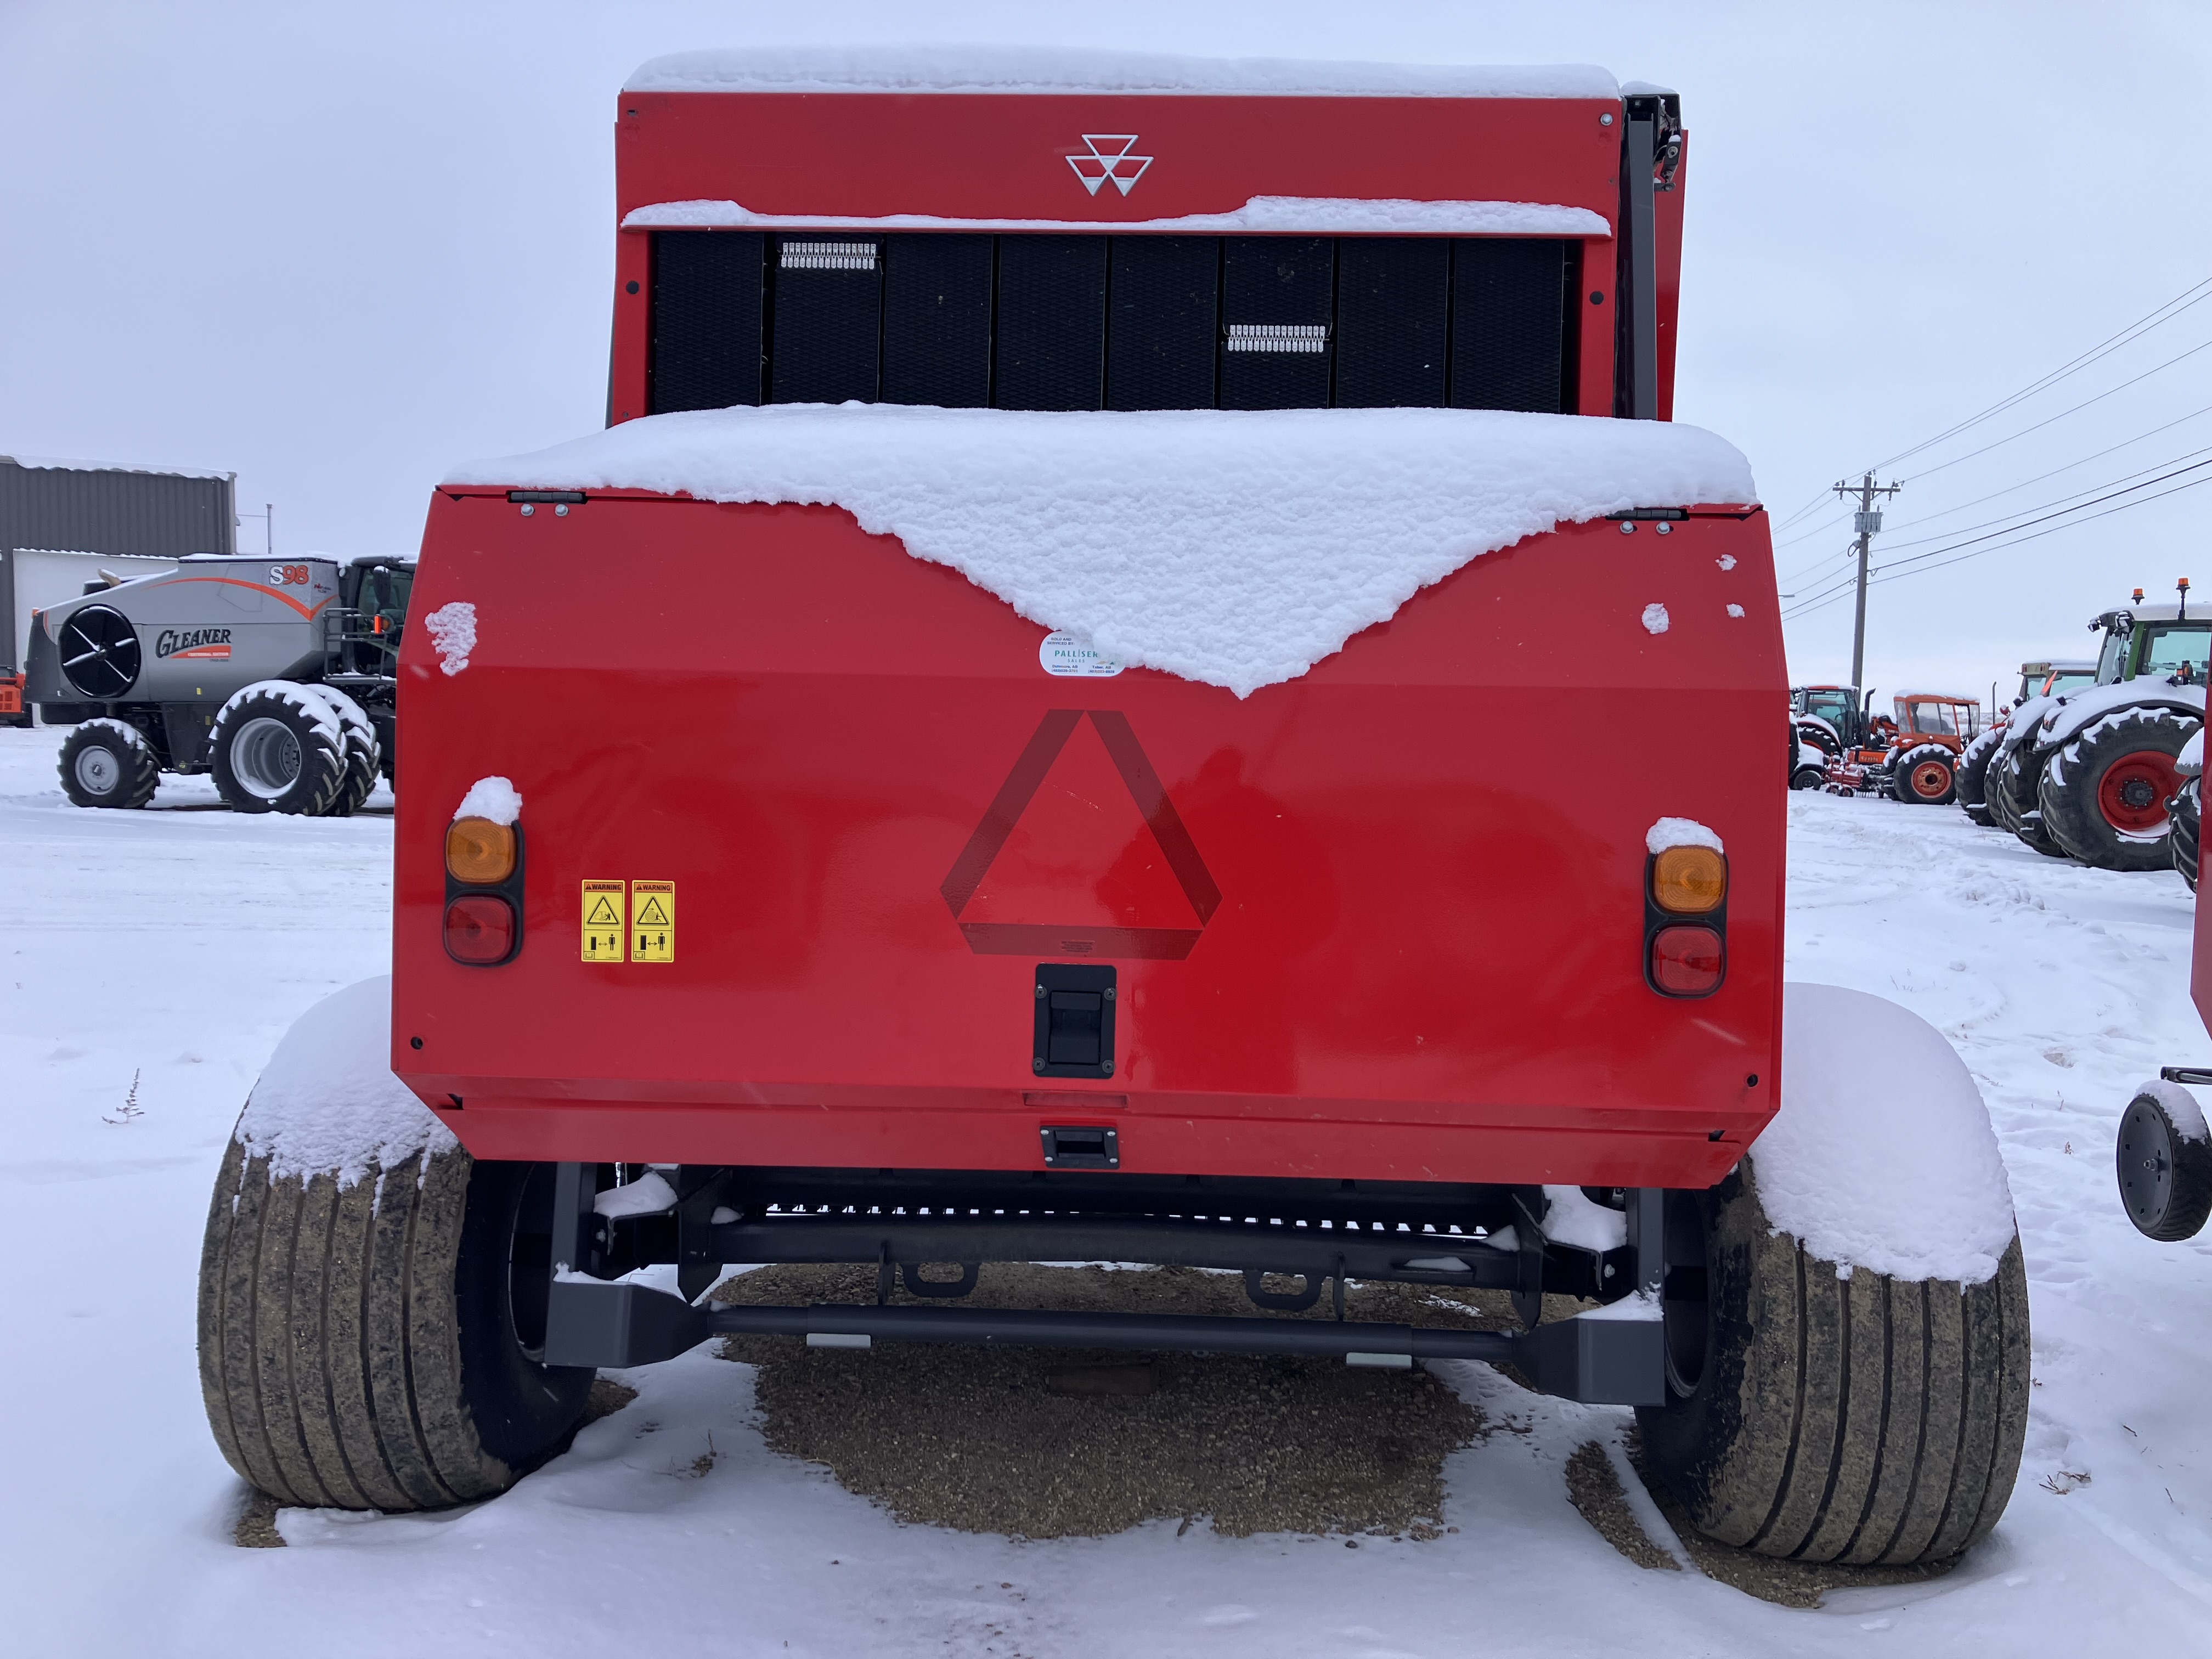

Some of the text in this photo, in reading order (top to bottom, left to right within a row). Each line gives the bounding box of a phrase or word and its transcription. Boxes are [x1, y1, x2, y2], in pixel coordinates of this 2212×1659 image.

[269, 565, 309, 585] S98
[155, 629, 232, 658] GLEANER
[1054, 649, 1098, 658] PALLISER
